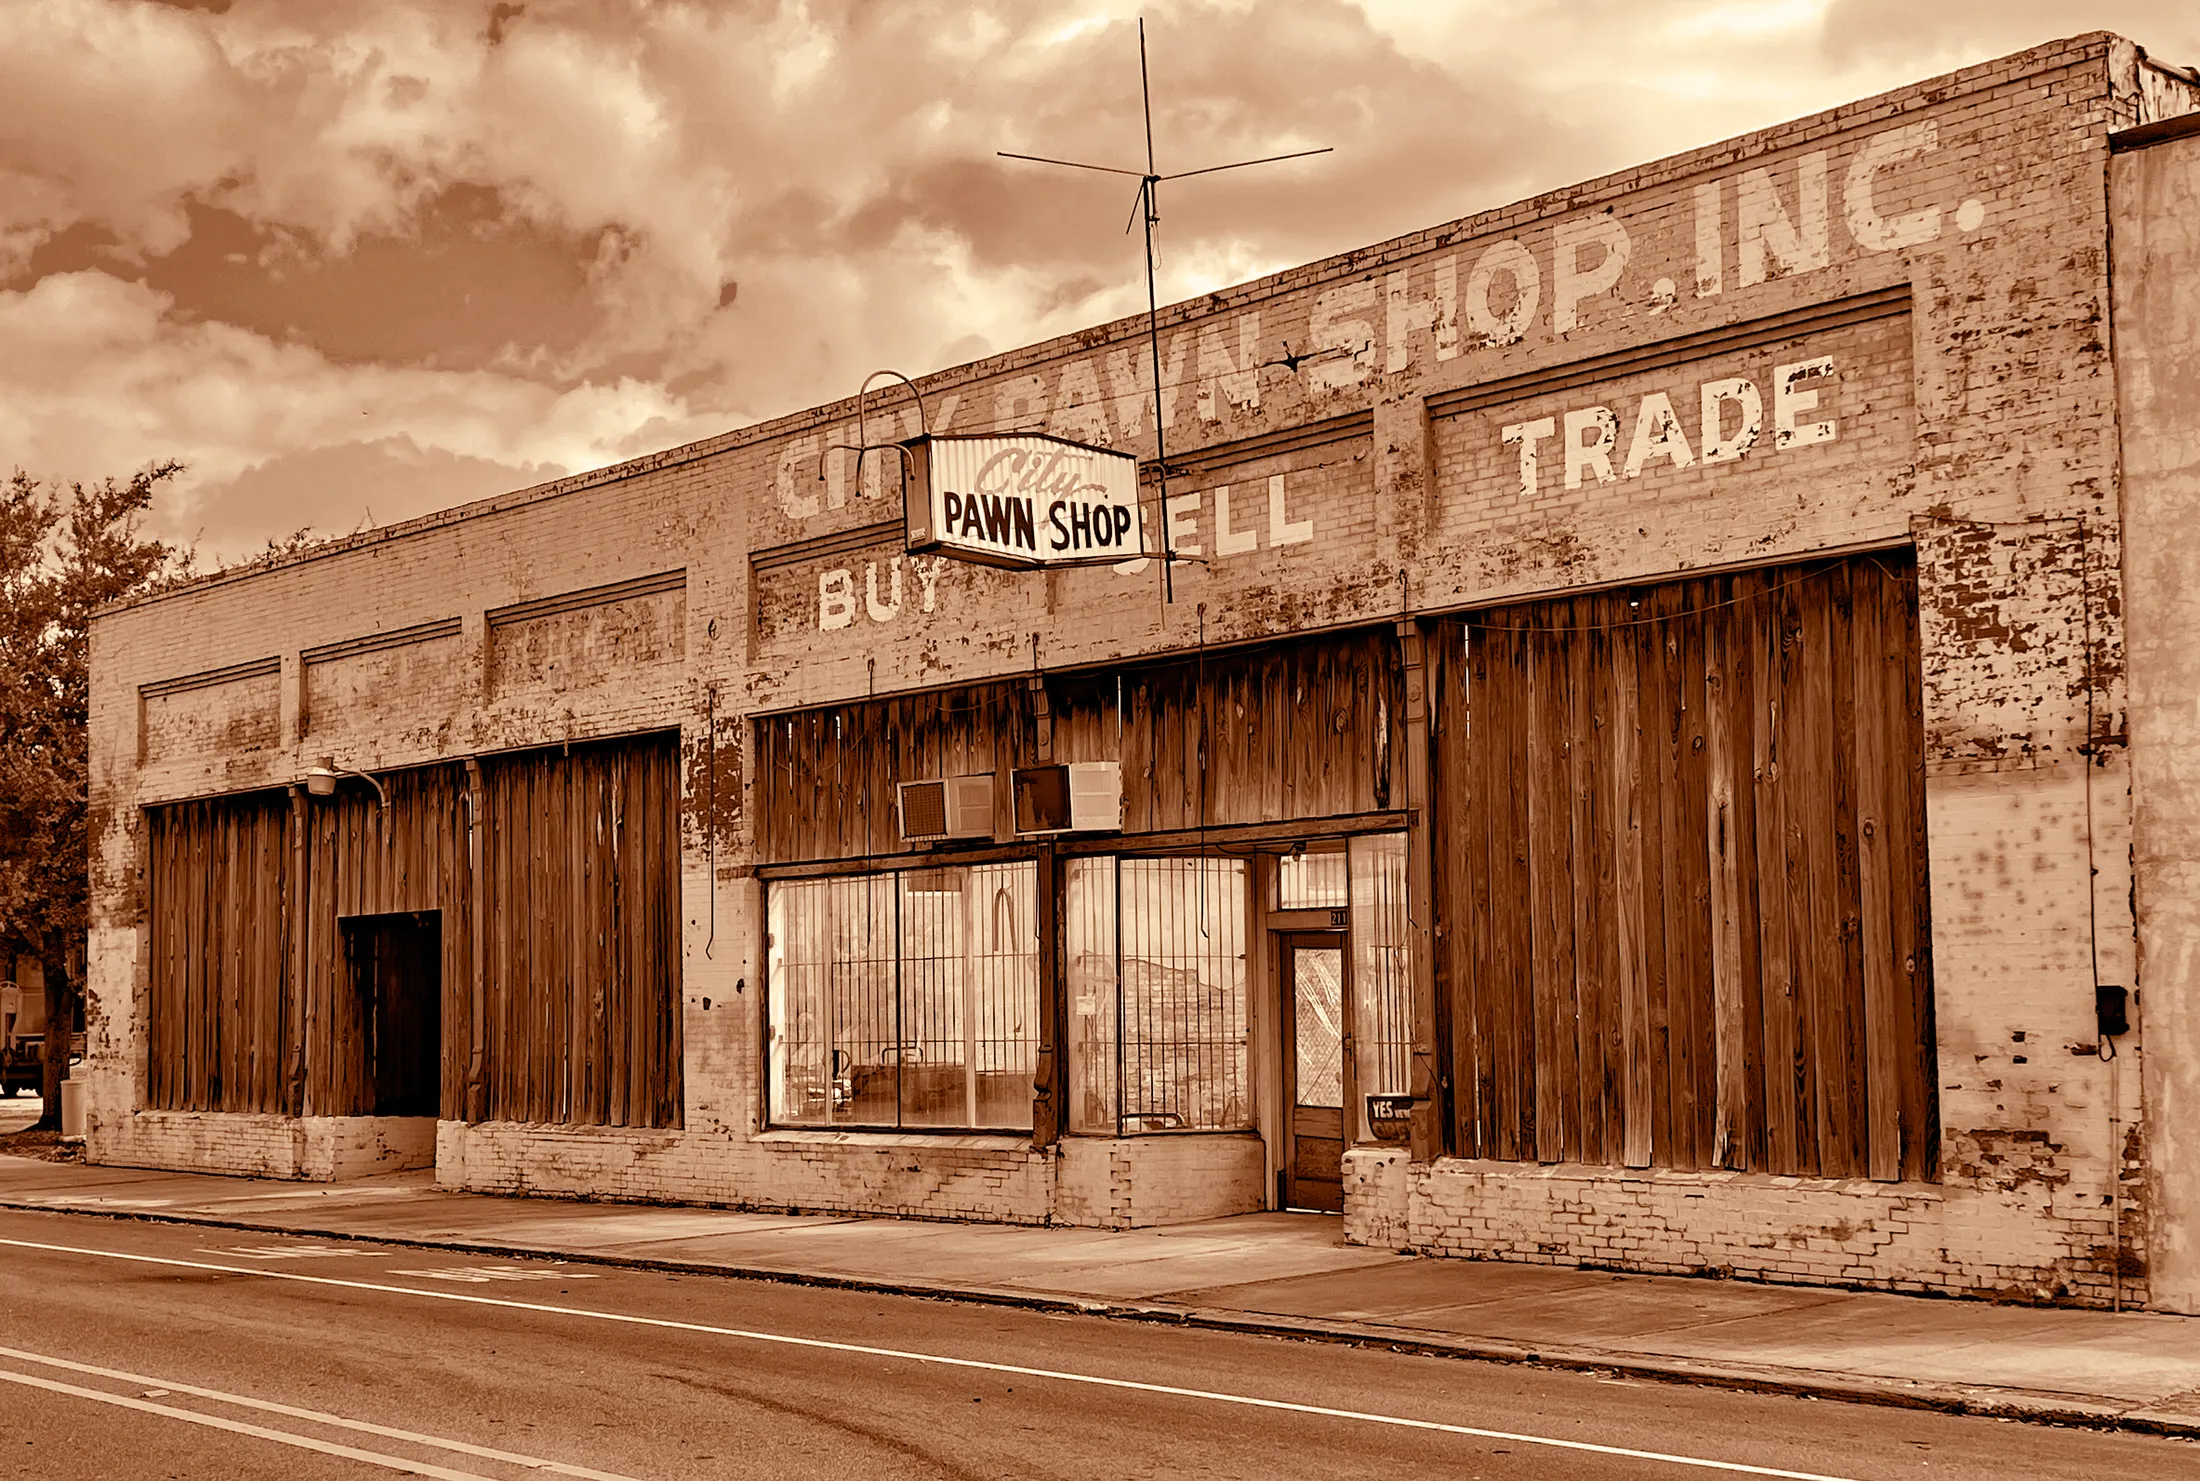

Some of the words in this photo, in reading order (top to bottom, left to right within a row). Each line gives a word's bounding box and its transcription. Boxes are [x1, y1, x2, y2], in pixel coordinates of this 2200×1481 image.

[994, 311, 1261, 446] PAWN
[1694, 113, 1985, 299] INC.
[819, 556, 948, 632] BUY
[1501, 355, 1836, 496] TRADE
[974, 446, 1108, 501] City
[943, 491, 1035, 551] PAWN
[1050, 500, 1131, 551] SHOP
[1331, 912, 1346, 924] 211
[1372, 1101, 1393, 1119] YES
[385, 1266, 601, 1283] BIKE
